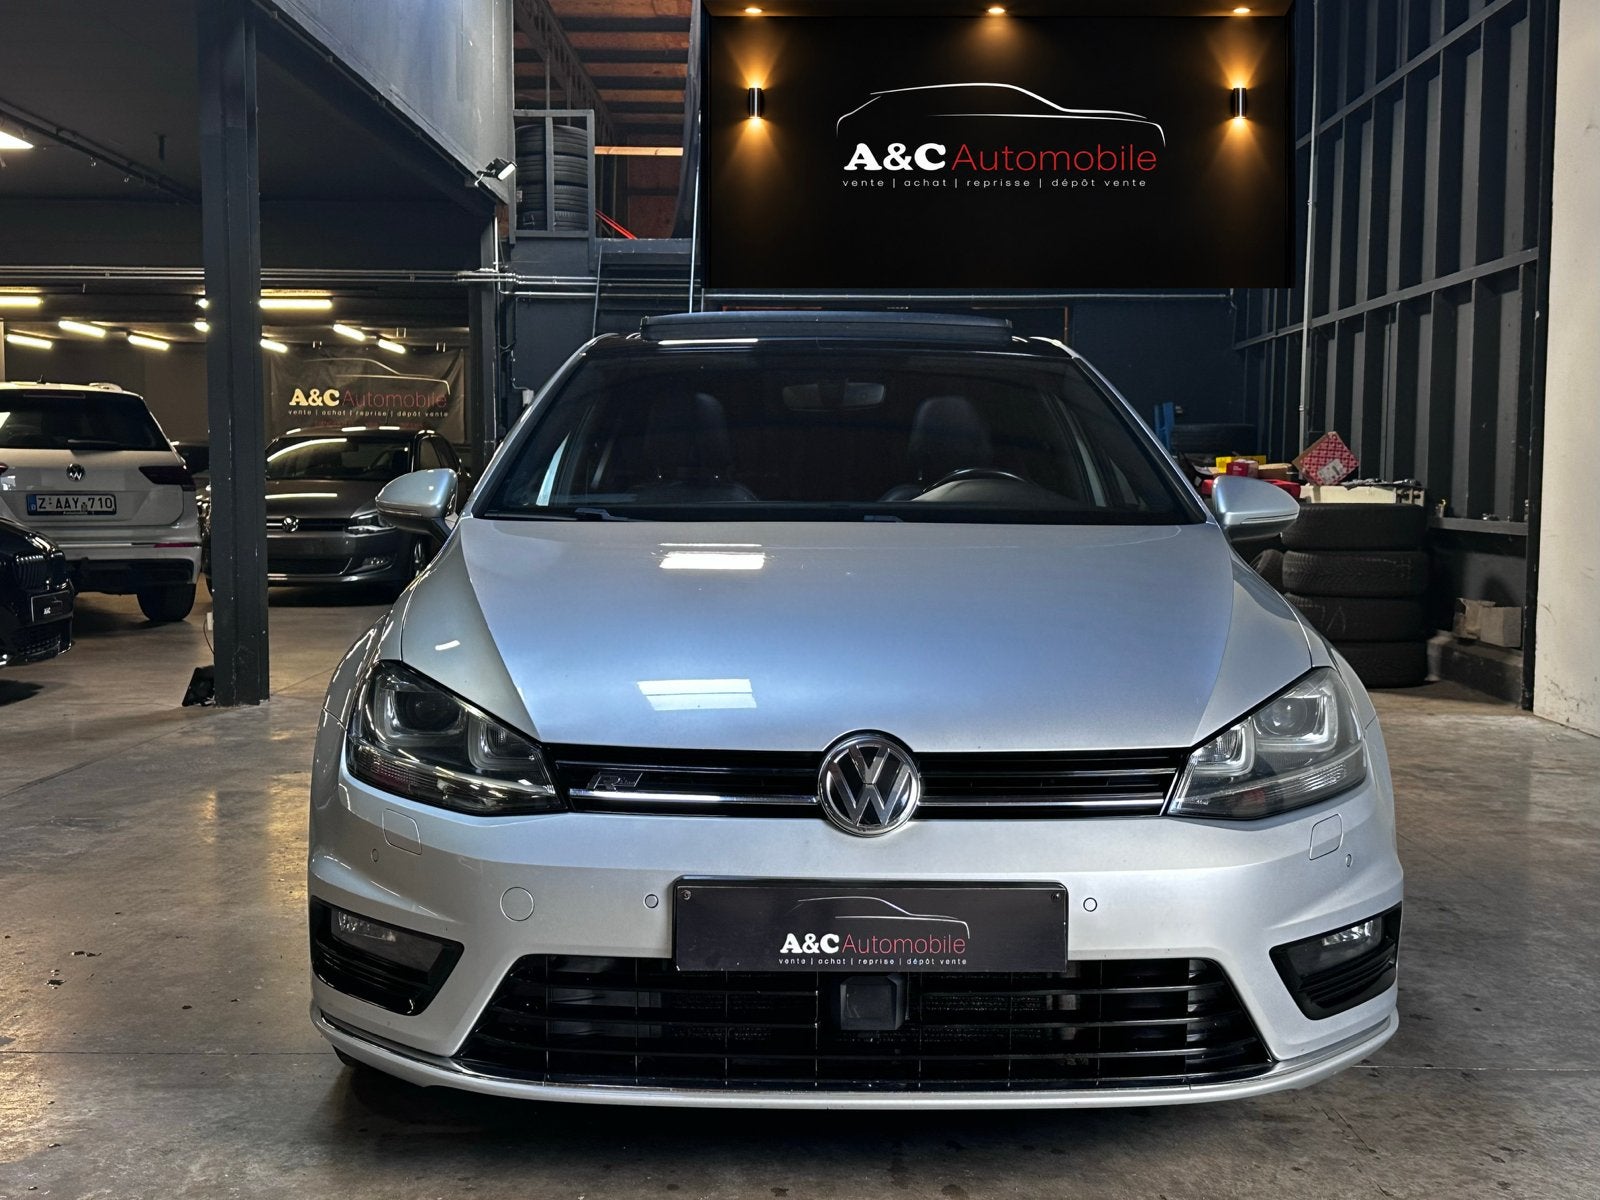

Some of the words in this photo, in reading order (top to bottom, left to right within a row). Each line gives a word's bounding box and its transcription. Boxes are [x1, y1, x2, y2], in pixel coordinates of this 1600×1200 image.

[843, 142, 947, 171] A&C
[951, 143, 1157, 171] Automobile
[842, 179, 884, 187] vente
[903, 178, 947, 187] achat
[966, 178, 1030, 189] reprisse
[1051, 178, 1095, 189] dépôt
[1104, 179, 1146, 187] vente
[288, 388, 340, 407] A&C
[342, 390, 448, 409] Automobile
[779, 932, 840, 954] A&C
[841, 934, 966, 954] Automobile
[818, 957, 846, 965] achat
[858, 958, 895, 967] reprise
[906, 957, 935, 967] dépôt
